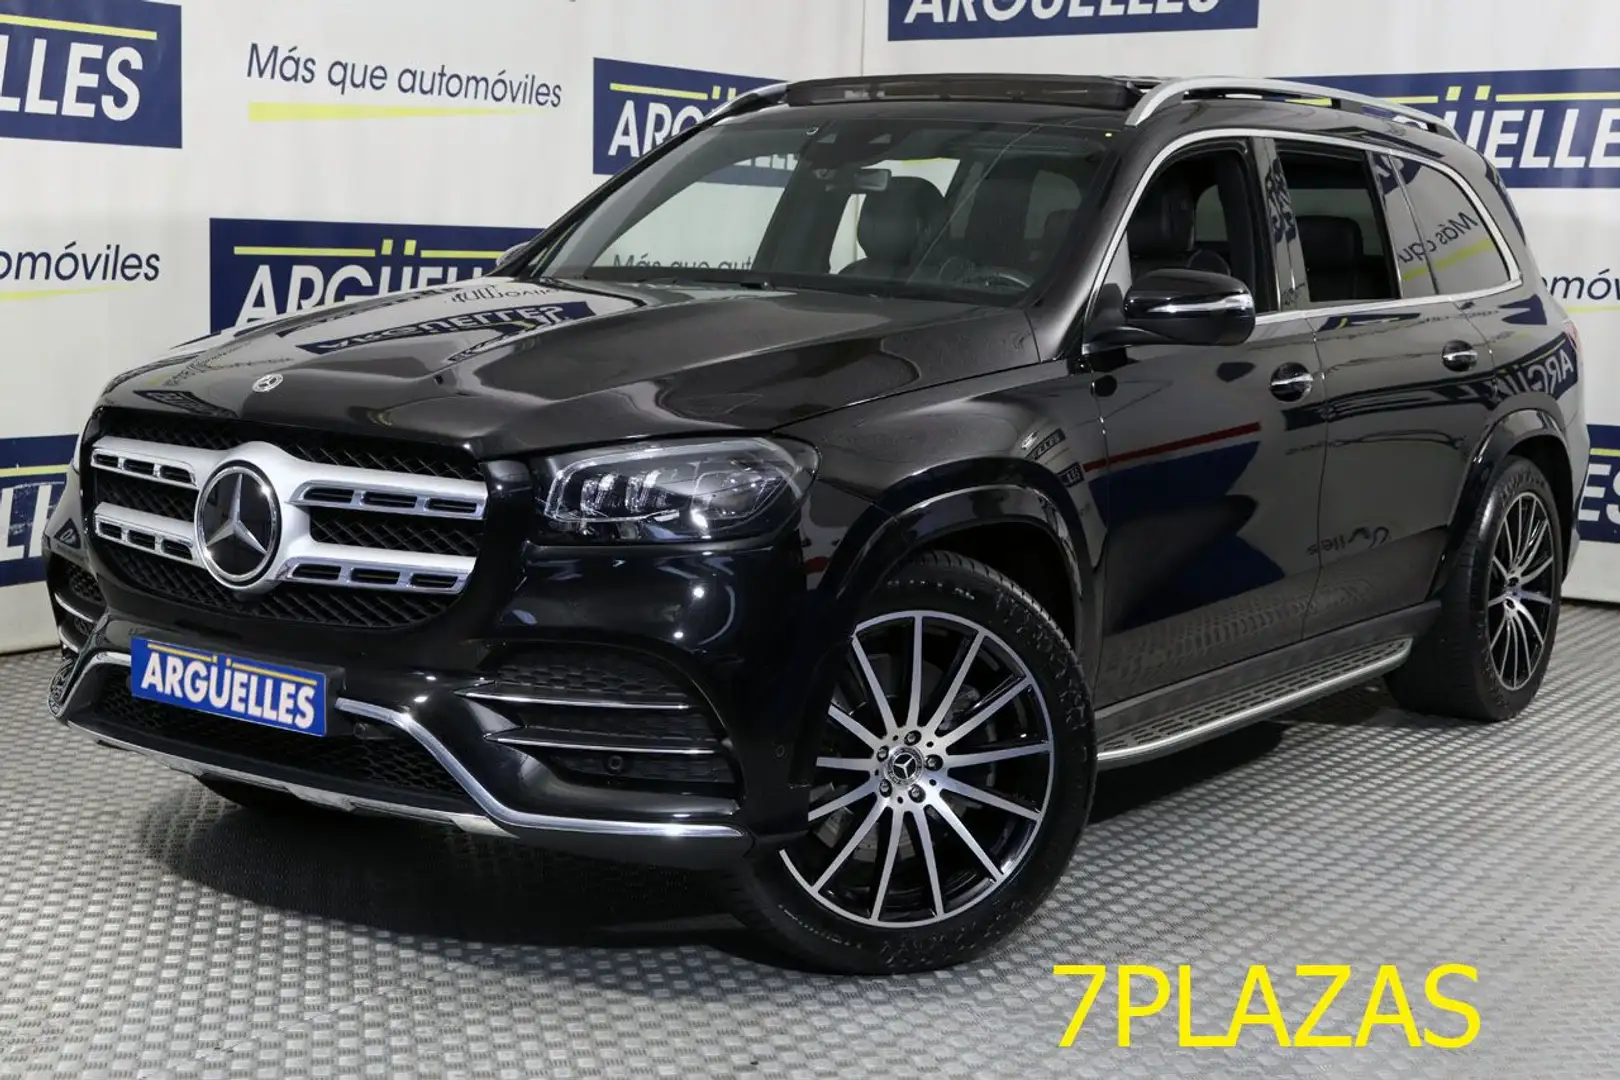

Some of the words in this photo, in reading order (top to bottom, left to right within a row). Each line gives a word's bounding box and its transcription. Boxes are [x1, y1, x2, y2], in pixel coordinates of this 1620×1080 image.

[247, 43, 316, 84] Más
[327, 60, 388, 95] que
[397, 65, 562, 108] automóviles
[141, 651, 316, 729] ARGÜELLES
